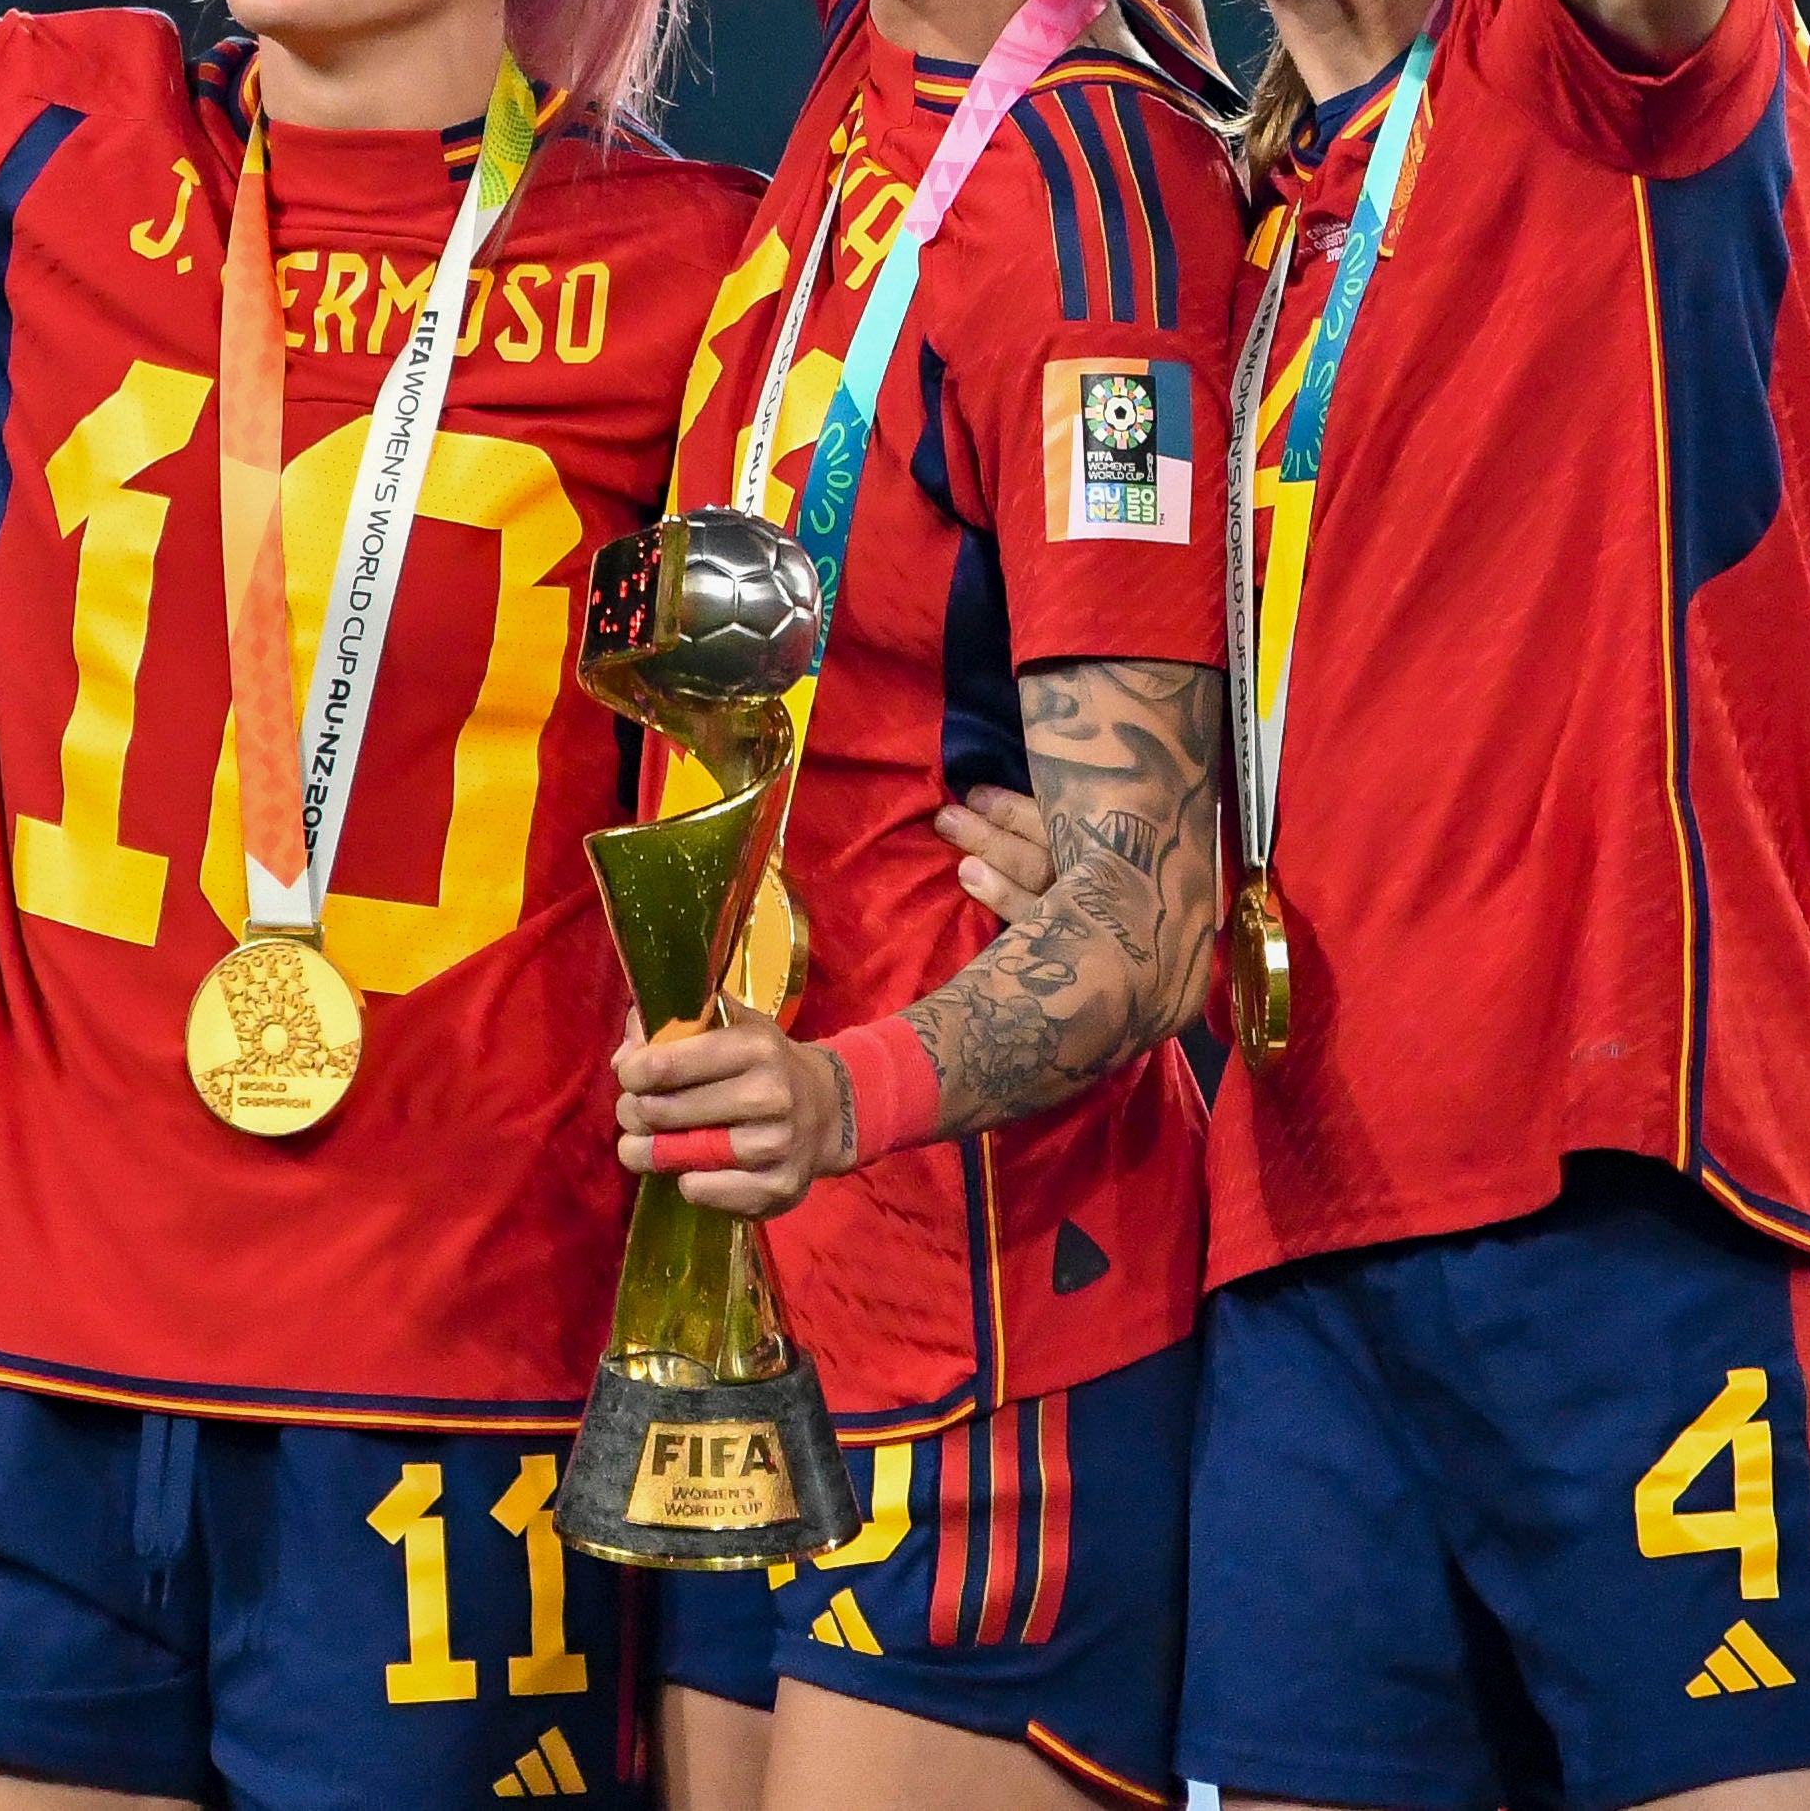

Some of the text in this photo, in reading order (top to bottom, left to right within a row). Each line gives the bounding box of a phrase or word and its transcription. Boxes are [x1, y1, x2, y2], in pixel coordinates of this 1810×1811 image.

[129, 157, 201, 276] J.
[408, 310, 439, 367] FIFA
[375, 370, 427, 503] WOMEN'S
[1087, 450, 1114, 462] FIFA
[1088, 462, 1136, 472] WOMEN'S
[1089, 471, 1145, 481] WORLD CUP
[1089, 485, 1156, 504] AU 20
[1088, 503, 1156, 522] NZ 23
[349, 509, 392, 612] WORLD
[1228, 491, 1244, 604] WORLD
[337, 616, 365, 676] CUP
[1235, 610, 1246, 671] CUP
[13, 359, 583, 997] 10
[239, 1082, 287, 1092] WORLD
[652, 1433, 780, 1478] FIFA
[1635, 1367, 1779, 1600] 4
[664, 1501, 763, 1517] WORLD CUP
[671, 1486, 755, 1501] WOMEN'S
[366, 1454, 588, 1704] 11
